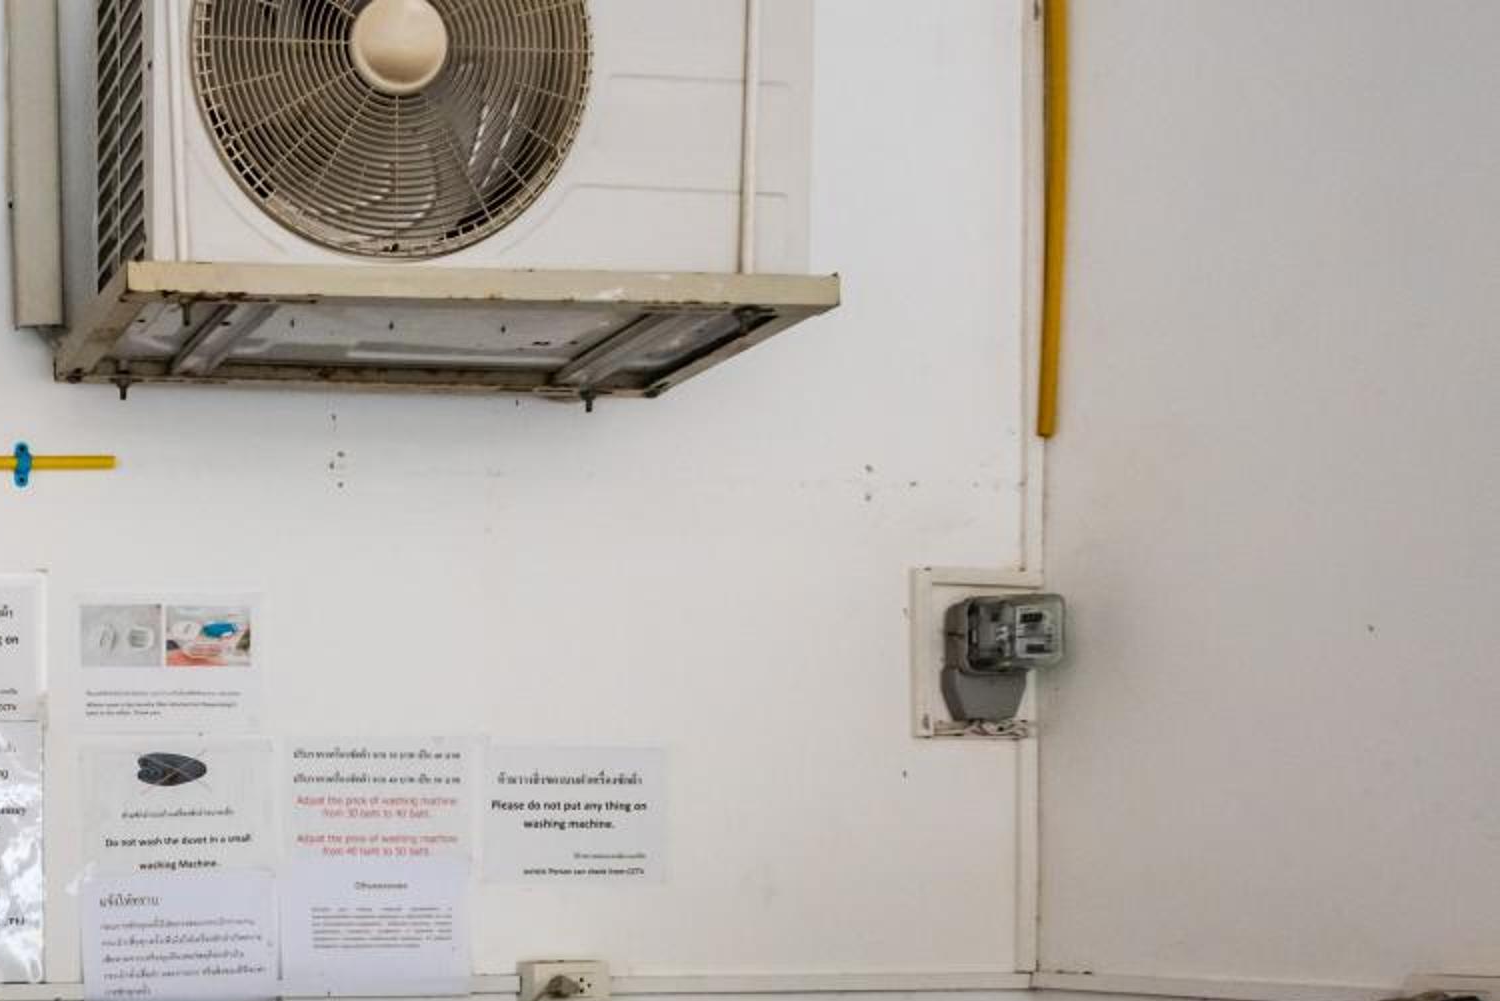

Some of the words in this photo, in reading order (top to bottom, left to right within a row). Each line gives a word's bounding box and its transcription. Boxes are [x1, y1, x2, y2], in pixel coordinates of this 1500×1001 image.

[5, 635, 19, 645] on
[327, 796, 343, 806] the
[345, 797, 368, 808] price
[369, 796, 380, 805] of
[491, 799, 525, 811] Please
[527, 799, 541, 811] do
[543, 800, 562, 811] not
[563, 800, 582, 813] put
[584, 802, 602, 813] any
[604, 800, 632, 813] thing
[633, 802, 648, 811] on
[522, 818, 567, 831] washing
[104, 838, 119, 848] Do
[121, 838, 138, 848] not
[138, 837, 163, 848] wash
[164, 836, 180, 846] the
[209, 836, 219, 845] in
[327, 835, 343, 844] the
[345, 836, 368, 846] price
[369, 835, 380, 844] of
[139, 861, 177, 872] washing
